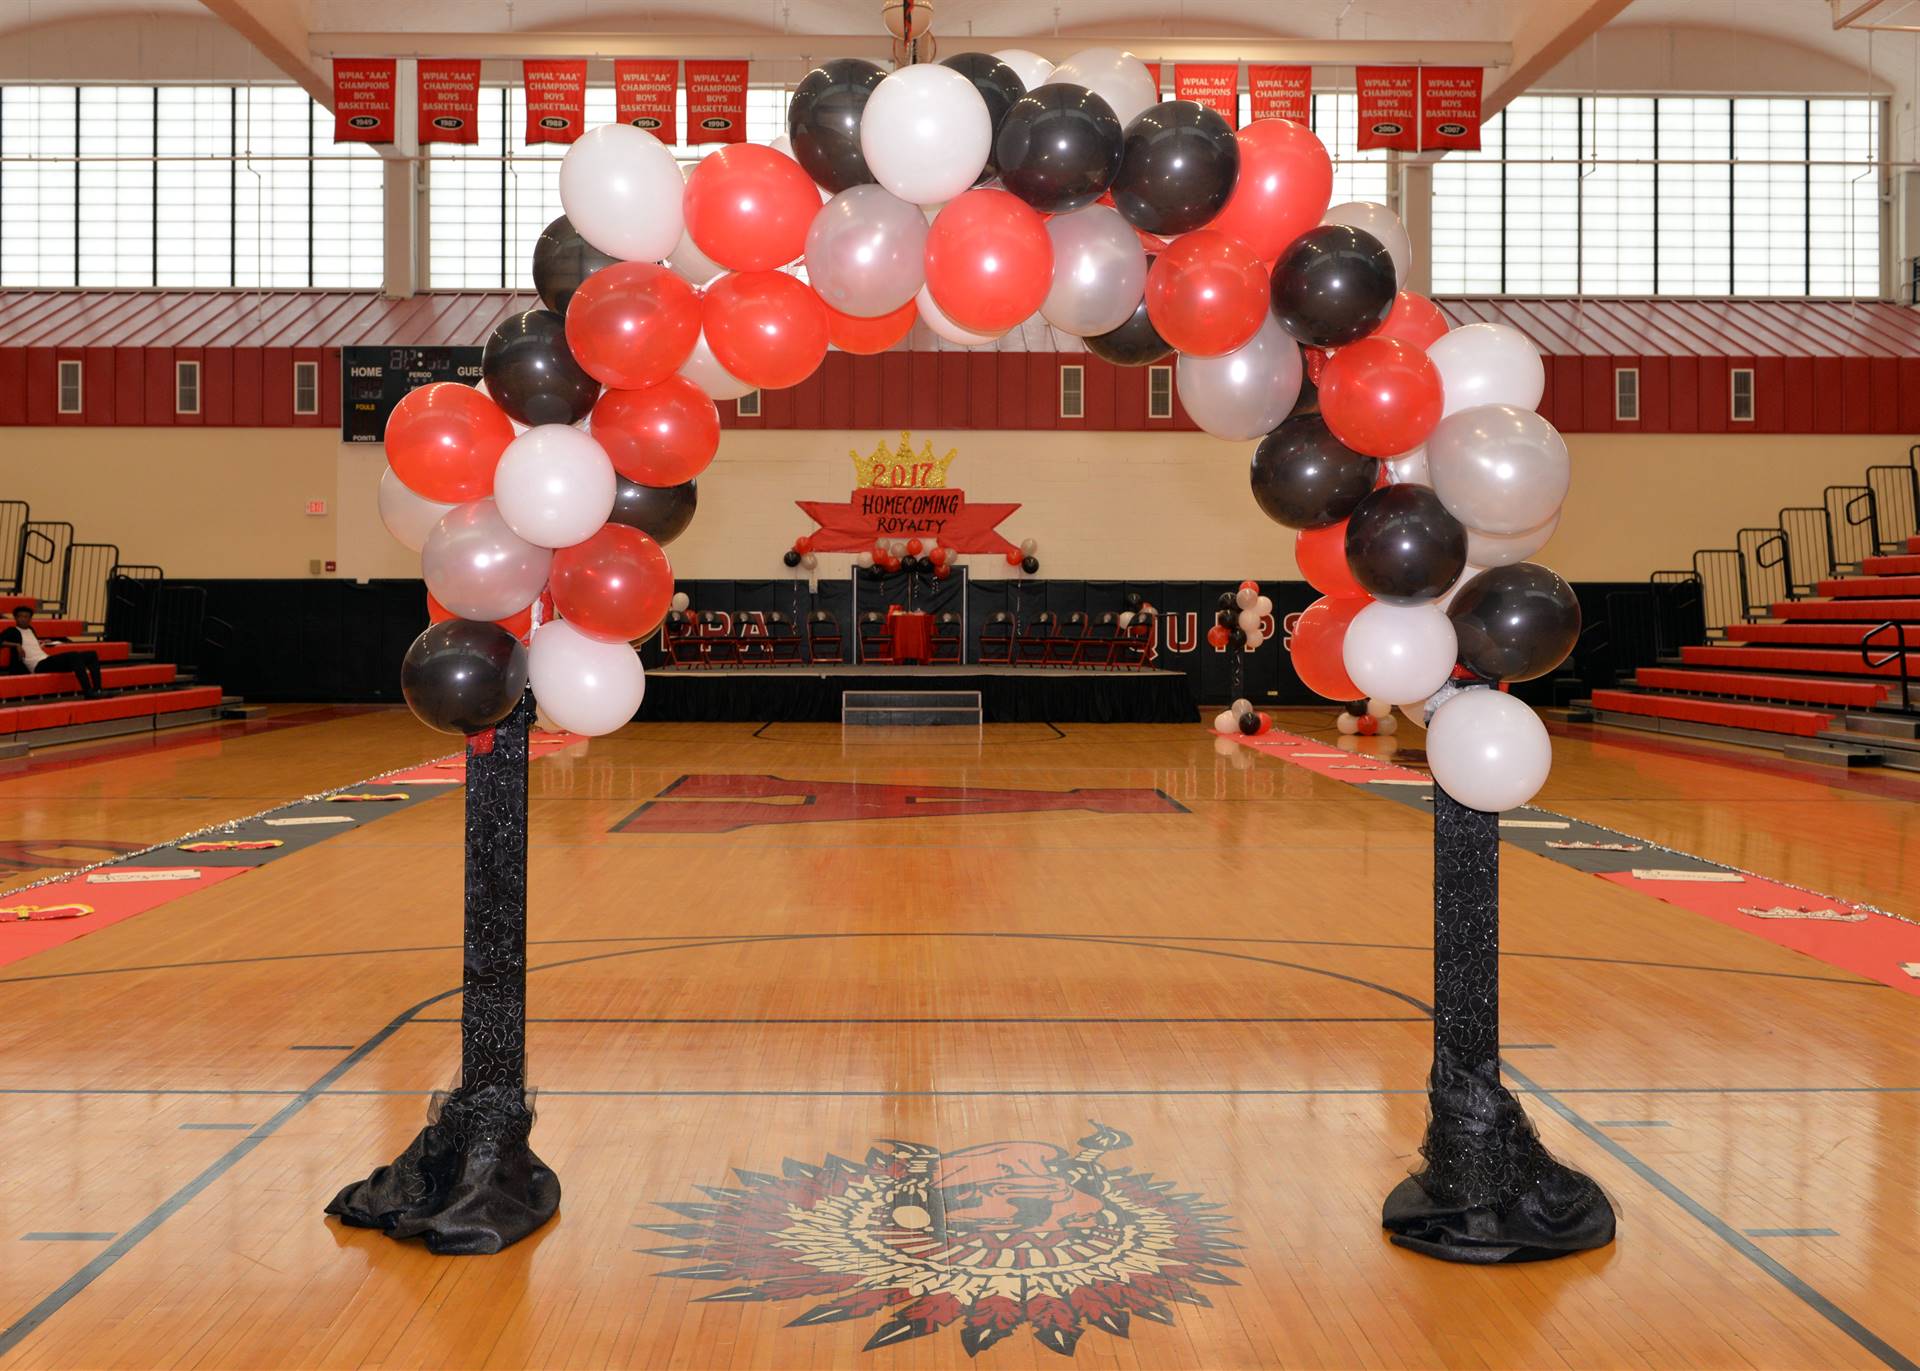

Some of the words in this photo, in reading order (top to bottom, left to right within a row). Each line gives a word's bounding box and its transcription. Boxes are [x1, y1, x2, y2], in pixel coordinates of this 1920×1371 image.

[337, 71, 364, 80] WPIAL
[422, 72, 449, 80] WPIAL
[527, 72, 554, 81] WPIAL
[623, 73, 650, 82] WPIAL
[693, 74, 720, 82] WPIAL
[339, 81, 390, 90] CHAMPIONS
[1182, 77, 1210, 86] WPIAL
[1256, 79, 1283, 88] WPIAL
[1364, 79, 1391, 87] WPIAL
[1427, 79, 1455, 88] WPIAL
[423, 82, 474, 91] CHAMPIONS
[529, 82, 580, 91] CHAMPIONS
[620, 83, 673, 92] CHAMPIONS
[691, 84, 743, 93] CHAMPIONS
[353, 91, 375, 100] BOYS
[437, 92, 459, 101] BOYS
[543, 92, 565, 101] BOYS
[1180, 87, 1232, 97] CHAMPIONS
[1254, 90, 1306, 98] CHAMPIONS
[1362, 89, 1413, 98] CHAMPIONS
[1426, 89, 1477, 98] CHAMPIONS
[635, 94, 657, 102] BOYS
[706, 94, 728, 103] BOYS
[337, 102, 390, 110] BASKETBALL
[422, 102, 474, 111] BASKETBALL
[528, 102, 580, 112] BASKETBALL
[620, 104, 673, 112] BASKETBALL
[1270, 100, 1291, 108] BOYS
[1376, 99, 1399, 108] BOYS
[1441, 99, 1462, 108] BOYS
[691, 104, 743, 113] BASKETBALL
[1254, 110, 1305, 119] BASKETBALL
[1361, 109, 1413, 118] BASKETBALL
[1425, 109, 1477, 119] BASKETBALL
[350, 366, 383, 377] HOME
[408, 371, 432, 379] PERIOD
[456, 366, 484, 377] GUES
[355, 403, 376, 411] FOULS
[352, 434, 377, 442] POINTS
[872, 463, 934, 489] 2017
[862, 494, 960, 516] HOMECOMING
[876, 516, 948, 534] ROYALTY
